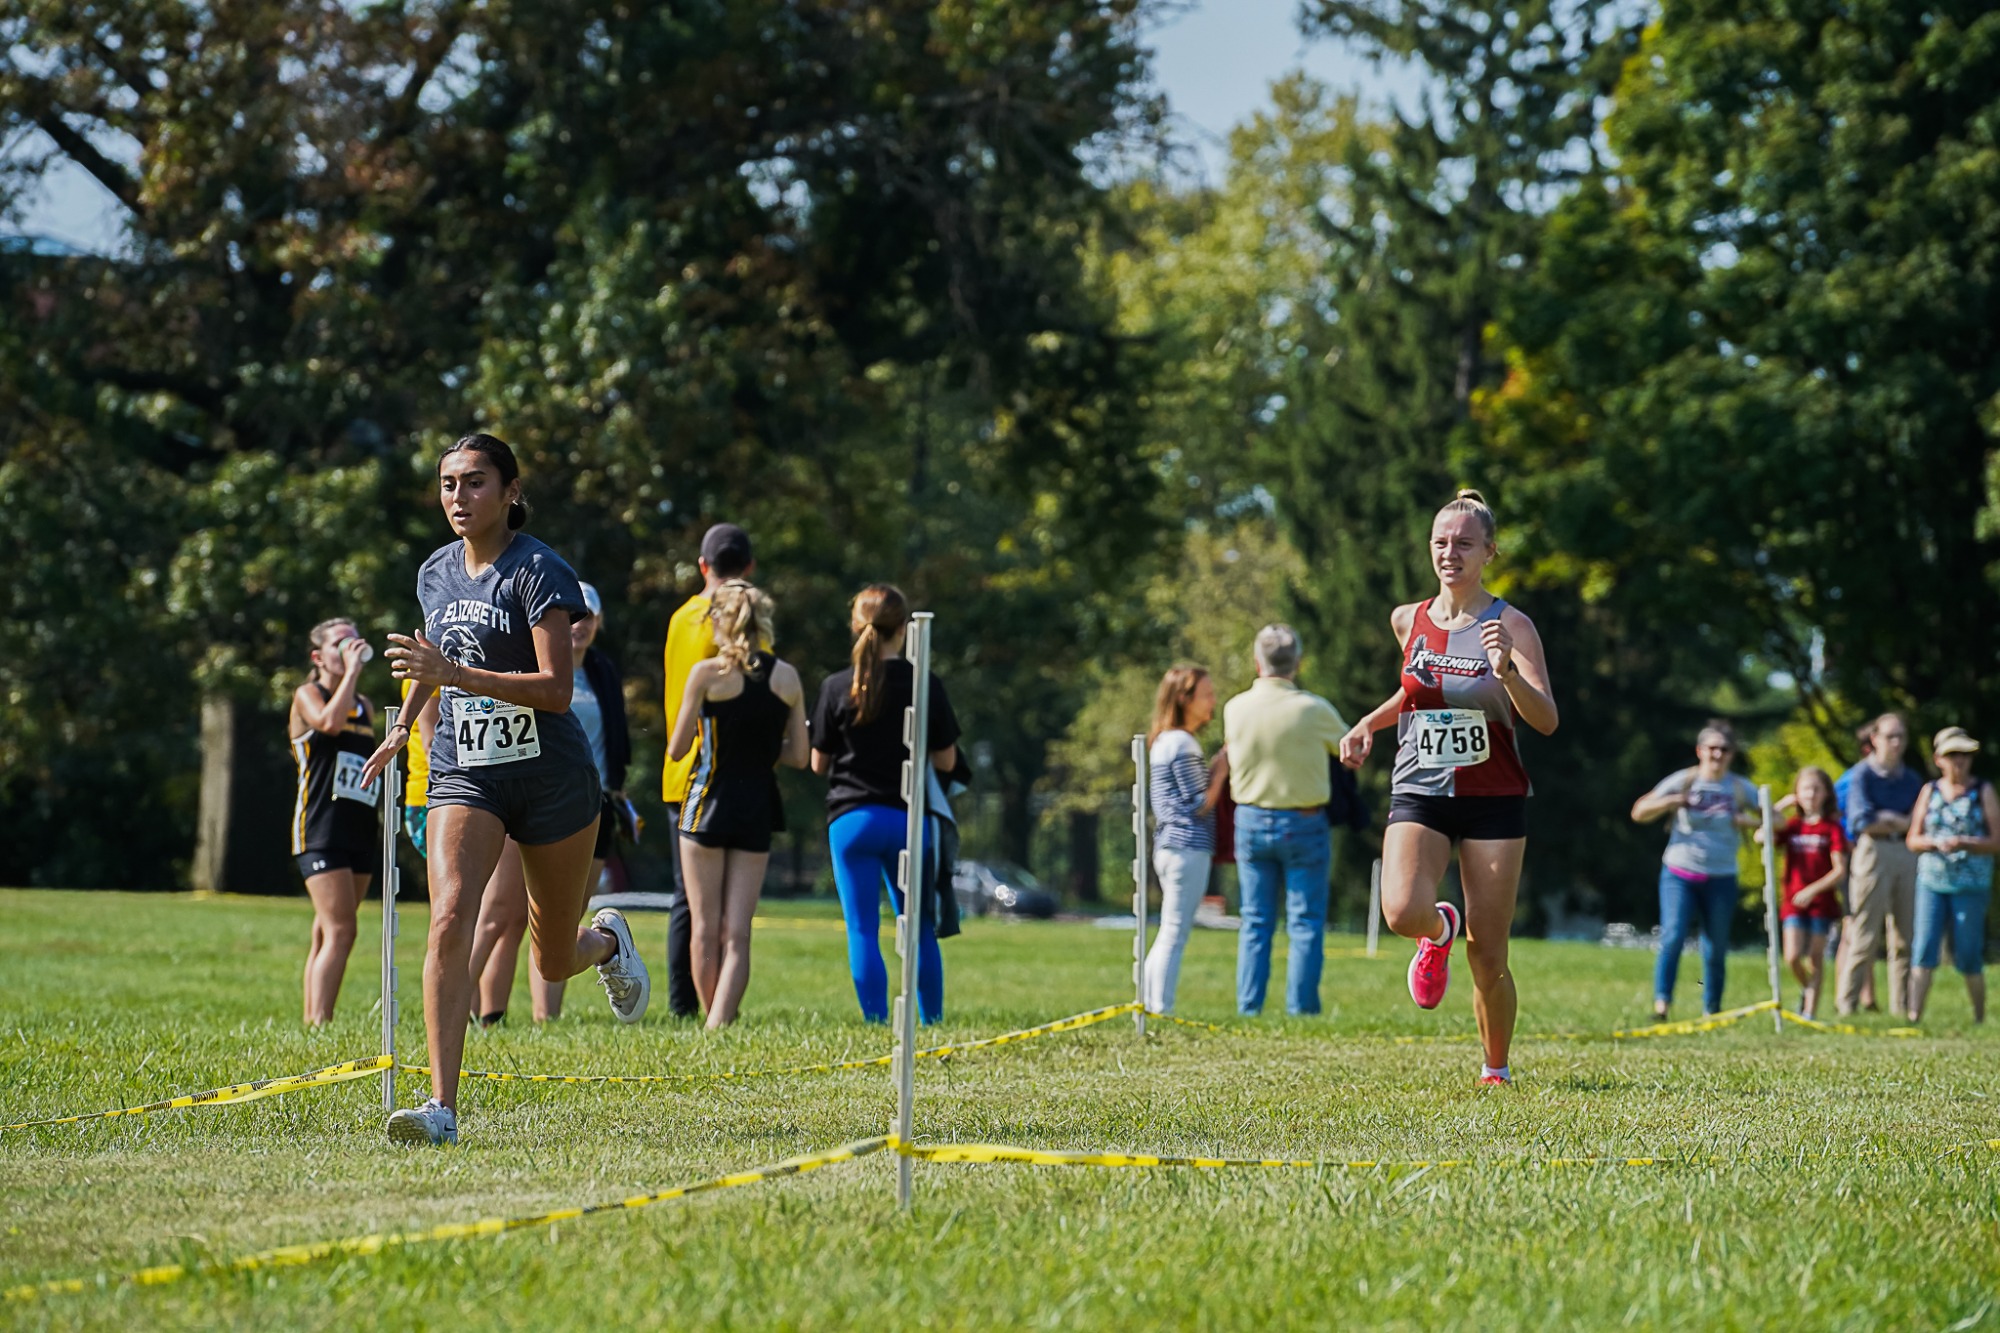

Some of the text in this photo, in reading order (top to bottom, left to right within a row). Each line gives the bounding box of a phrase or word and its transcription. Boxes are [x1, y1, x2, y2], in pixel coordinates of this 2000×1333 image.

[440, 599, 511, 635] ELIZABETH
[464, 701, 481, 713] 2L
[1425, 713, 1441, 723] 2L
[458, 713, 536, 752] 4732
[1420, 725, 1486, 755] 4758
